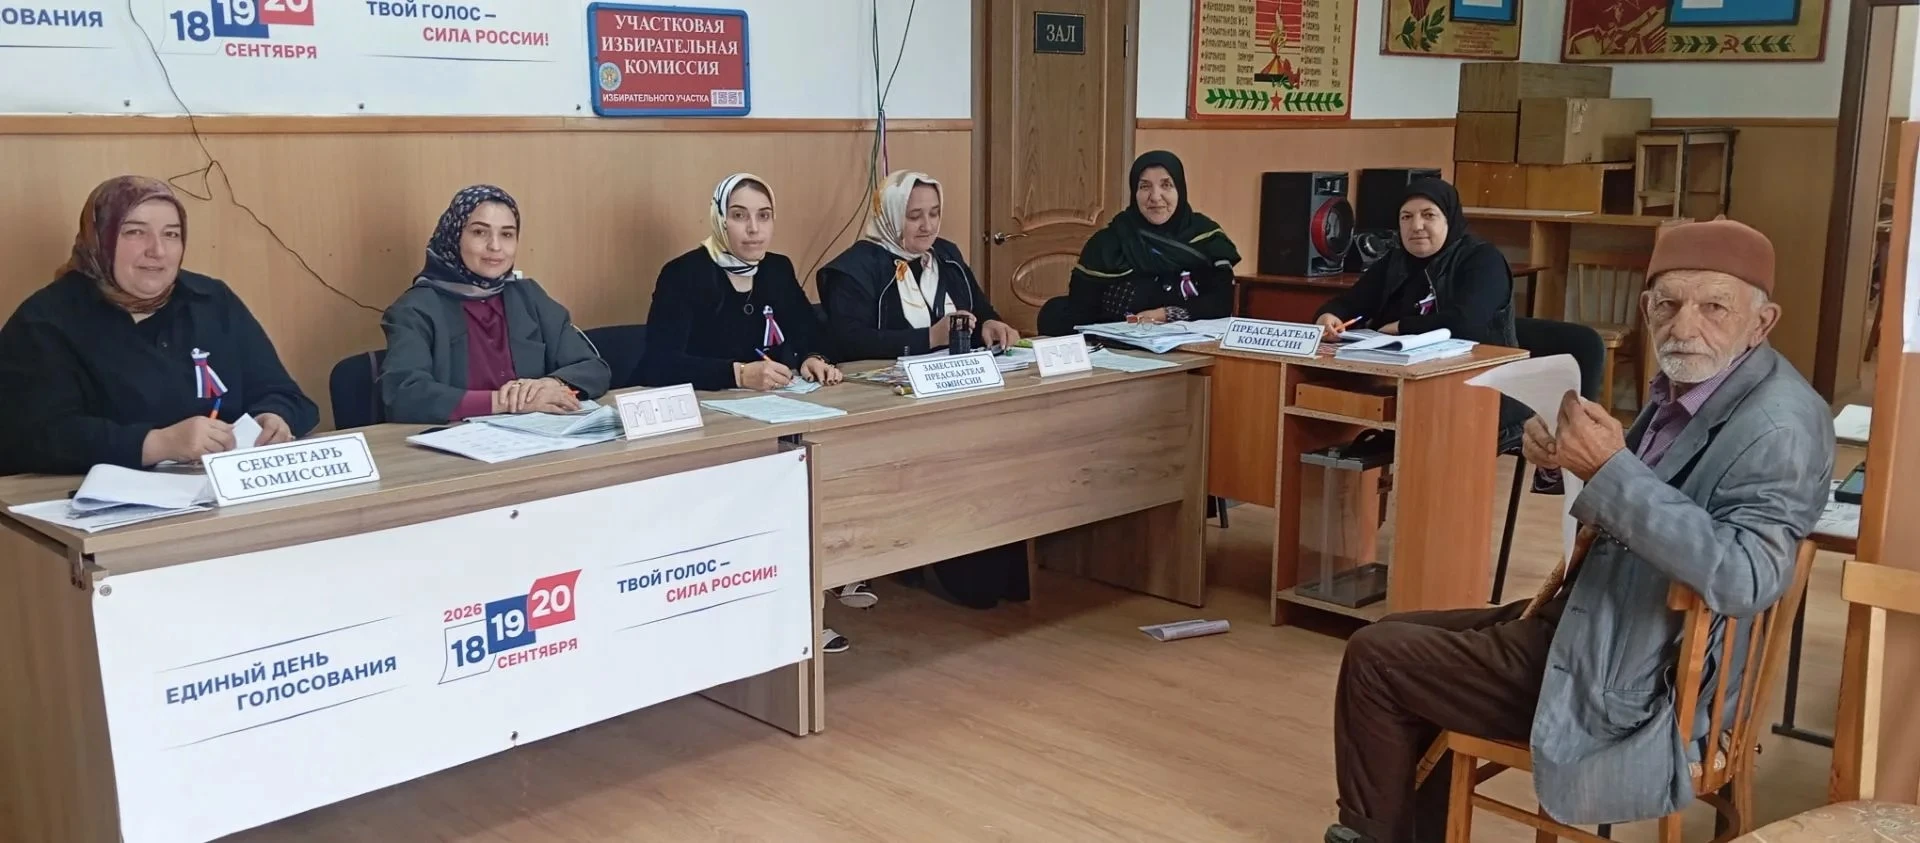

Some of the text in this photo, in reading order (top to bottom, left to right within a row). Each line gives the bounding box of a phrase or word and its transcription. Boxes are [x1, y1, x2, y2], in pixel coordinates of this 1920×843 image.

[2, 7, 104, 28] ОВАНИЯ
[366, 0, 418, 18] ТВОЙ
[422, 4, 481, 21] ГОЛОС
[170, 10, 211, 42] 18
[614, 14, 725, 34] УЧАСТКОВАЯ
[1046, 24, 1075, 42] ЗАЛ
[423, 27, 550, 46] СИЛА РОССИИ!
[601, 36, 739, 55] ИЗБИРАТЕЛЬНАЯ
[225, 43, 318, 59] СЕНТЯБРЯ
[624, 59, 720, 75] КОМИССИЯ
[602, 93, 675, 103] ИЗБИРАТЕЛЬНОГО
[676, 94, 709, 103] УЧАСТКА
[1232, 324, 1316, 340] ПРЕДСЕДАТЕЛЬ
[1237, 336, 1304, 350] КОМИССИИ
[922, 358, 980, 372] ЗАМЕСТИТЕЛЬ
[924, 366, 986, 381] ПРЕДСЕДАТЕЛЯ
[935, 376, 982, 390] КОМИССИИ
[237, 446, 343, 473] СЕКРЕТАРЬ
[240, 462, 352, 490] КОМИССИИ
[617, 569, 662, 594] ТВОЙ
[665, 559, 717, 583] ГОЛОС
[666, 565, 778, 603] СИЛА РОССИИ!
[531, 584, 571, 619] 20
[443, 603, 483, 623] 2026
[490, 609, 525, 641] 19
[451, 635, 486, 668] 18
[497, 637, 578, 669] СЕНТЯБРЯ
[165, 651, 329, 705] ЕДИНЫЙ ДЕНЬ
[237, 656, 397, 711] ГОЛОСОВАНИЯ
